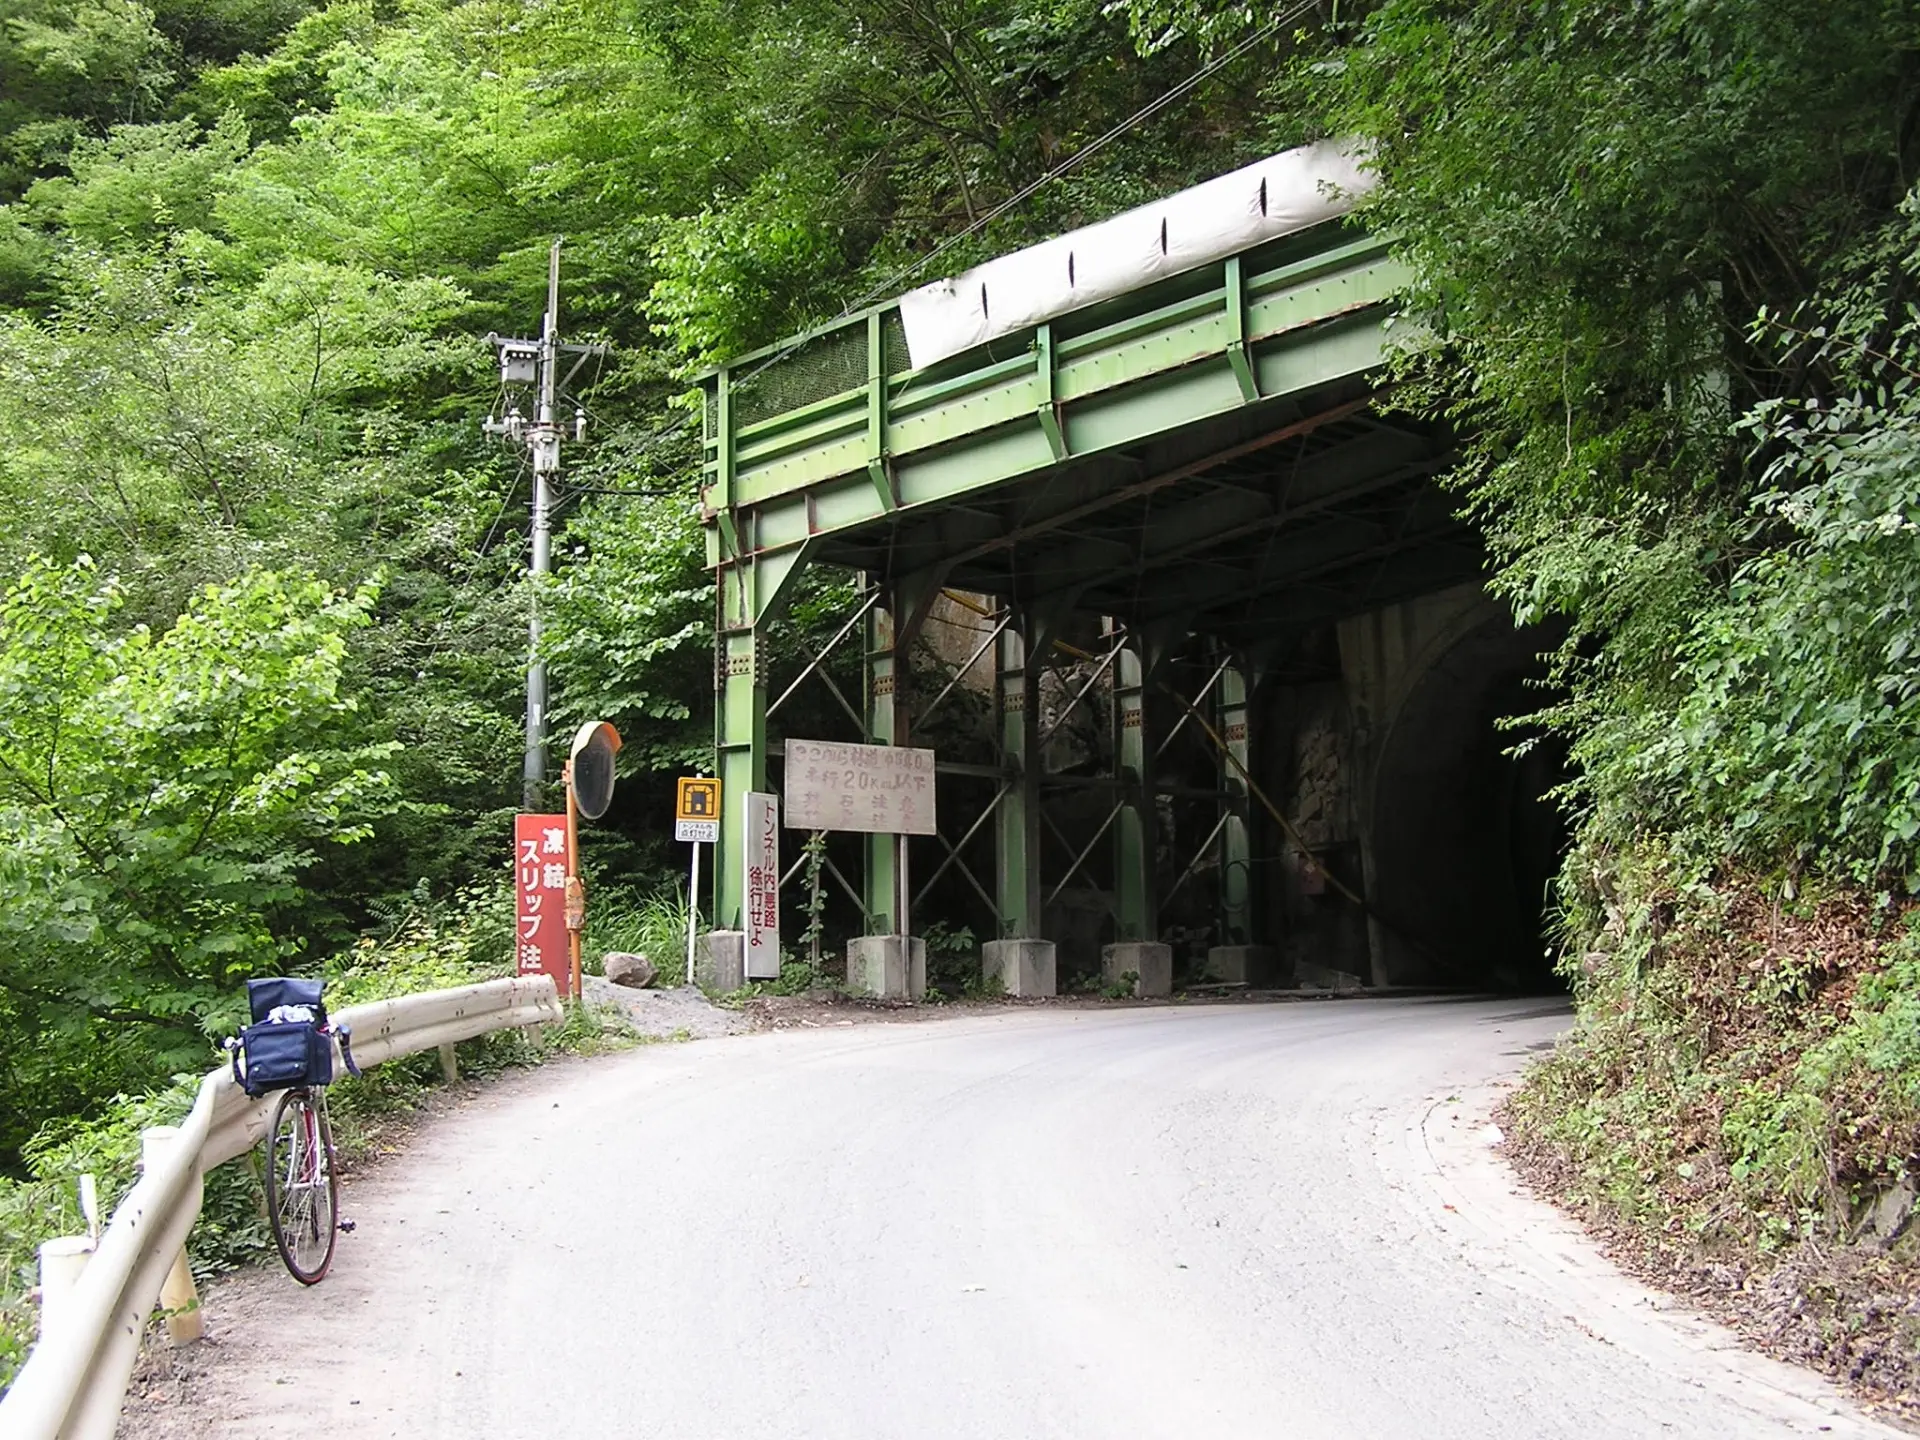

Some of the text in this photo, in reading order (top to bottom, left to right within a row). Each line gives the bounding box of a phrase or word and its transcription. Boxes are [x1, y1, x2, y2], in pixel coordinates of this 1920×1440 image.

[520, 840, 543, 977] スリップ注
[542, 827, 566, 889] 凍結
[748, 865, 763, 947] 徐行せよ
[763, 800, 776, 929] トンネル内悪路
